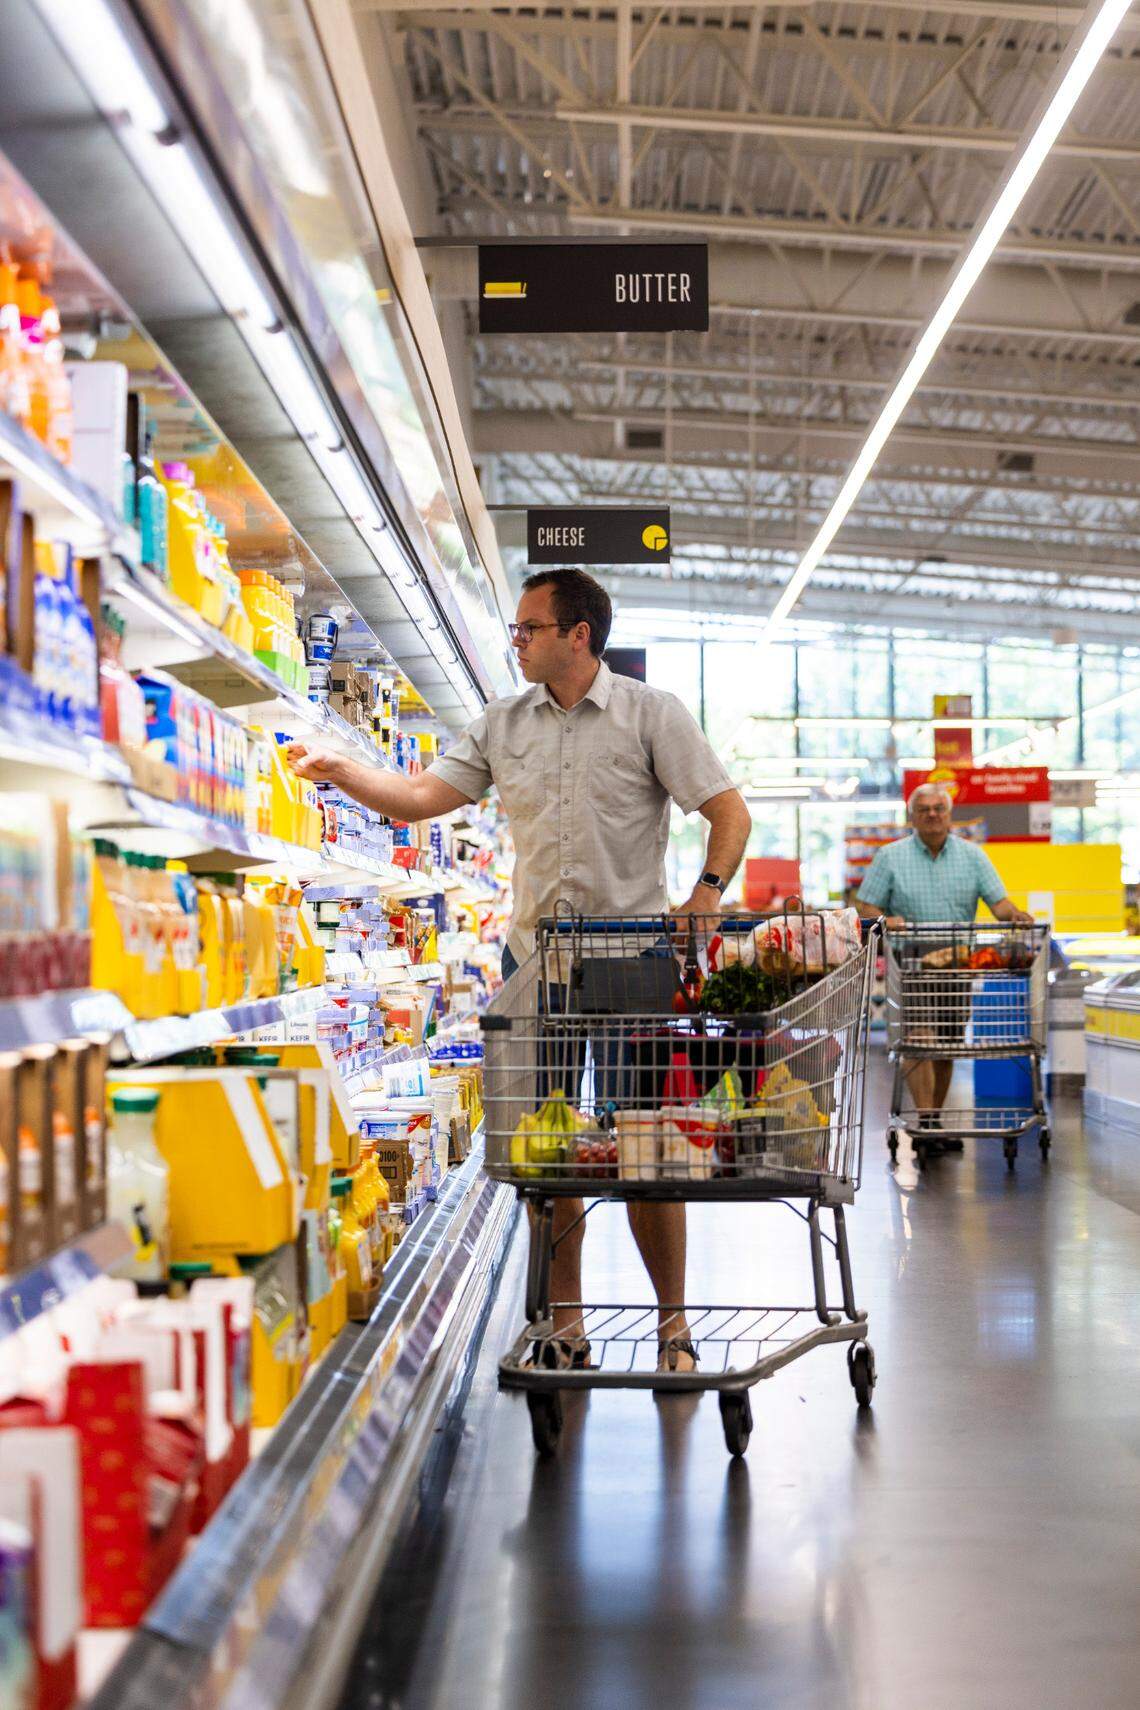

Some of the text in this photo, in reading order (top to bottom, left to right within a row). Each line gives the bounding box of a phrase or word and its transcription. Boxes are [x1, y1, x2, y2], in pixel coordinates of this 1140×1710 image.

[615, 273, 691, 303] BUTTER
[537, 527, 585, 547] CHEESE
[290, 1034, 310, 1042] KEFIR
